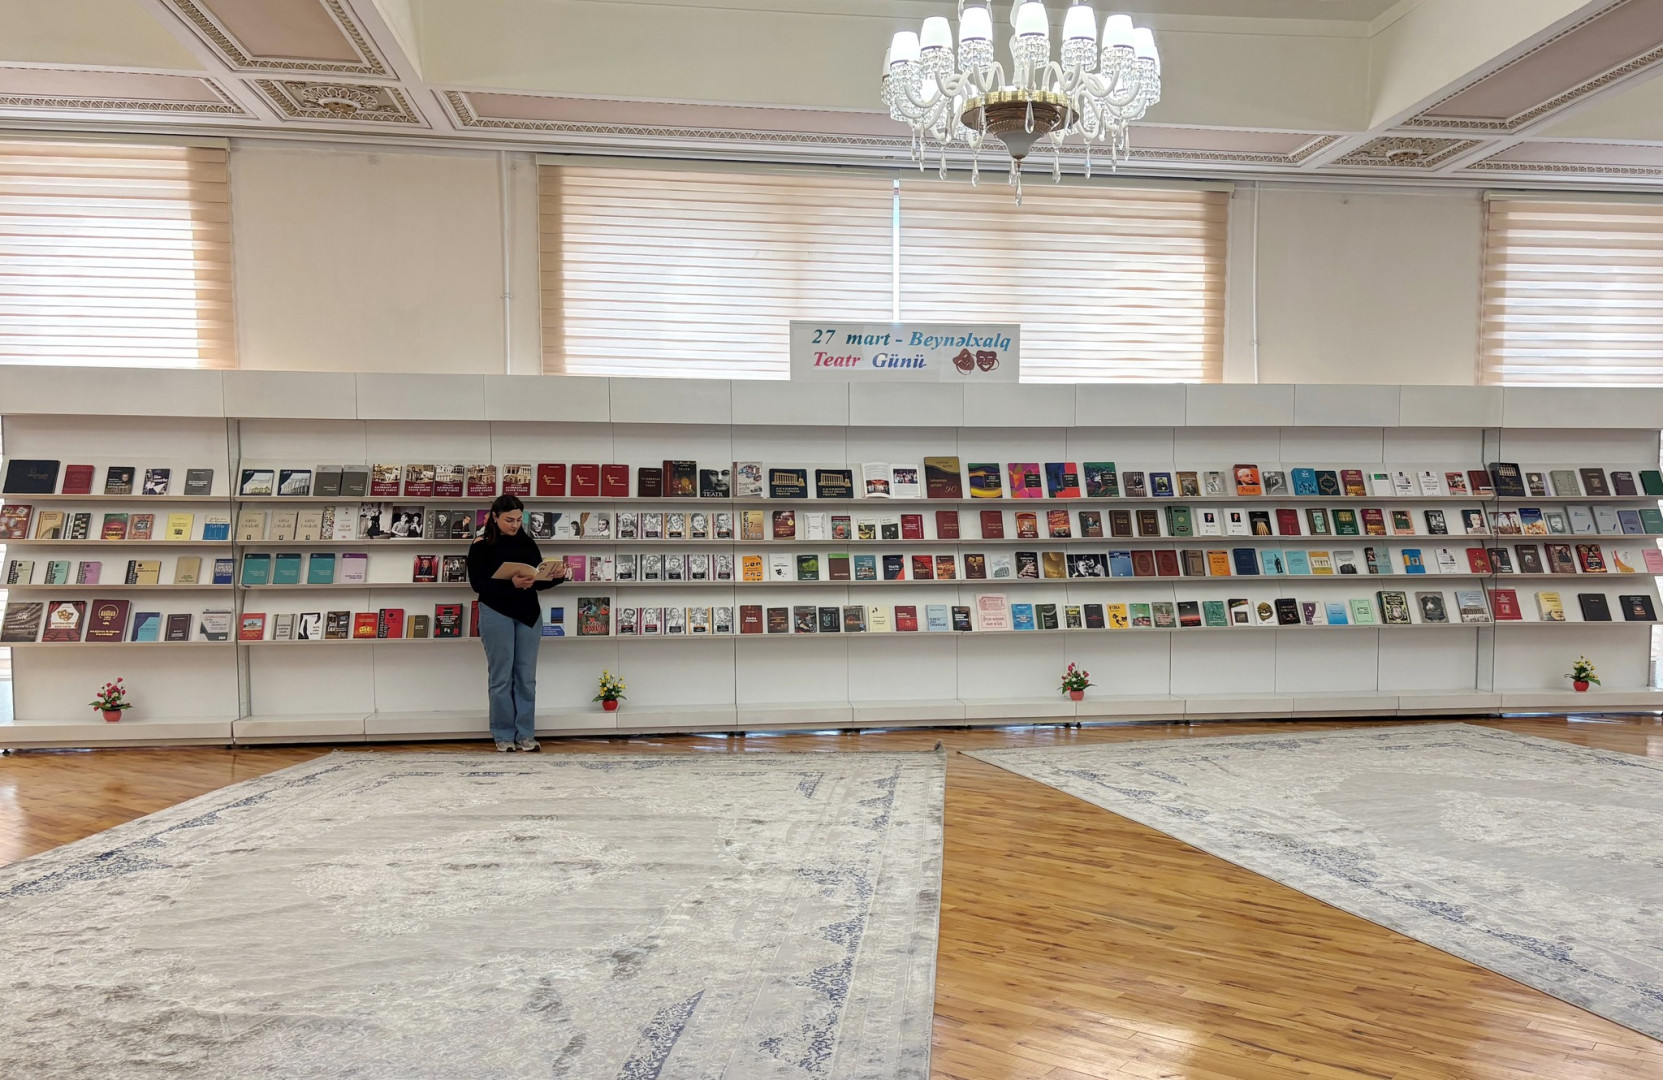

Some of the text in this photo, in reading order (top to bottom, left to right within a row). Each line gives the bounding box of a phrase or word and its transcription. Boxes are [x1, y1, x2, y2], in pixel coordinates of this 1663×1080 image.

[811, 329, 836, 345] 27
[845, 332, 891, 346] mart
[908, 331, 1012, 351] Beynəlxalq
[813, 351, 927, 368] Teatr Günü
